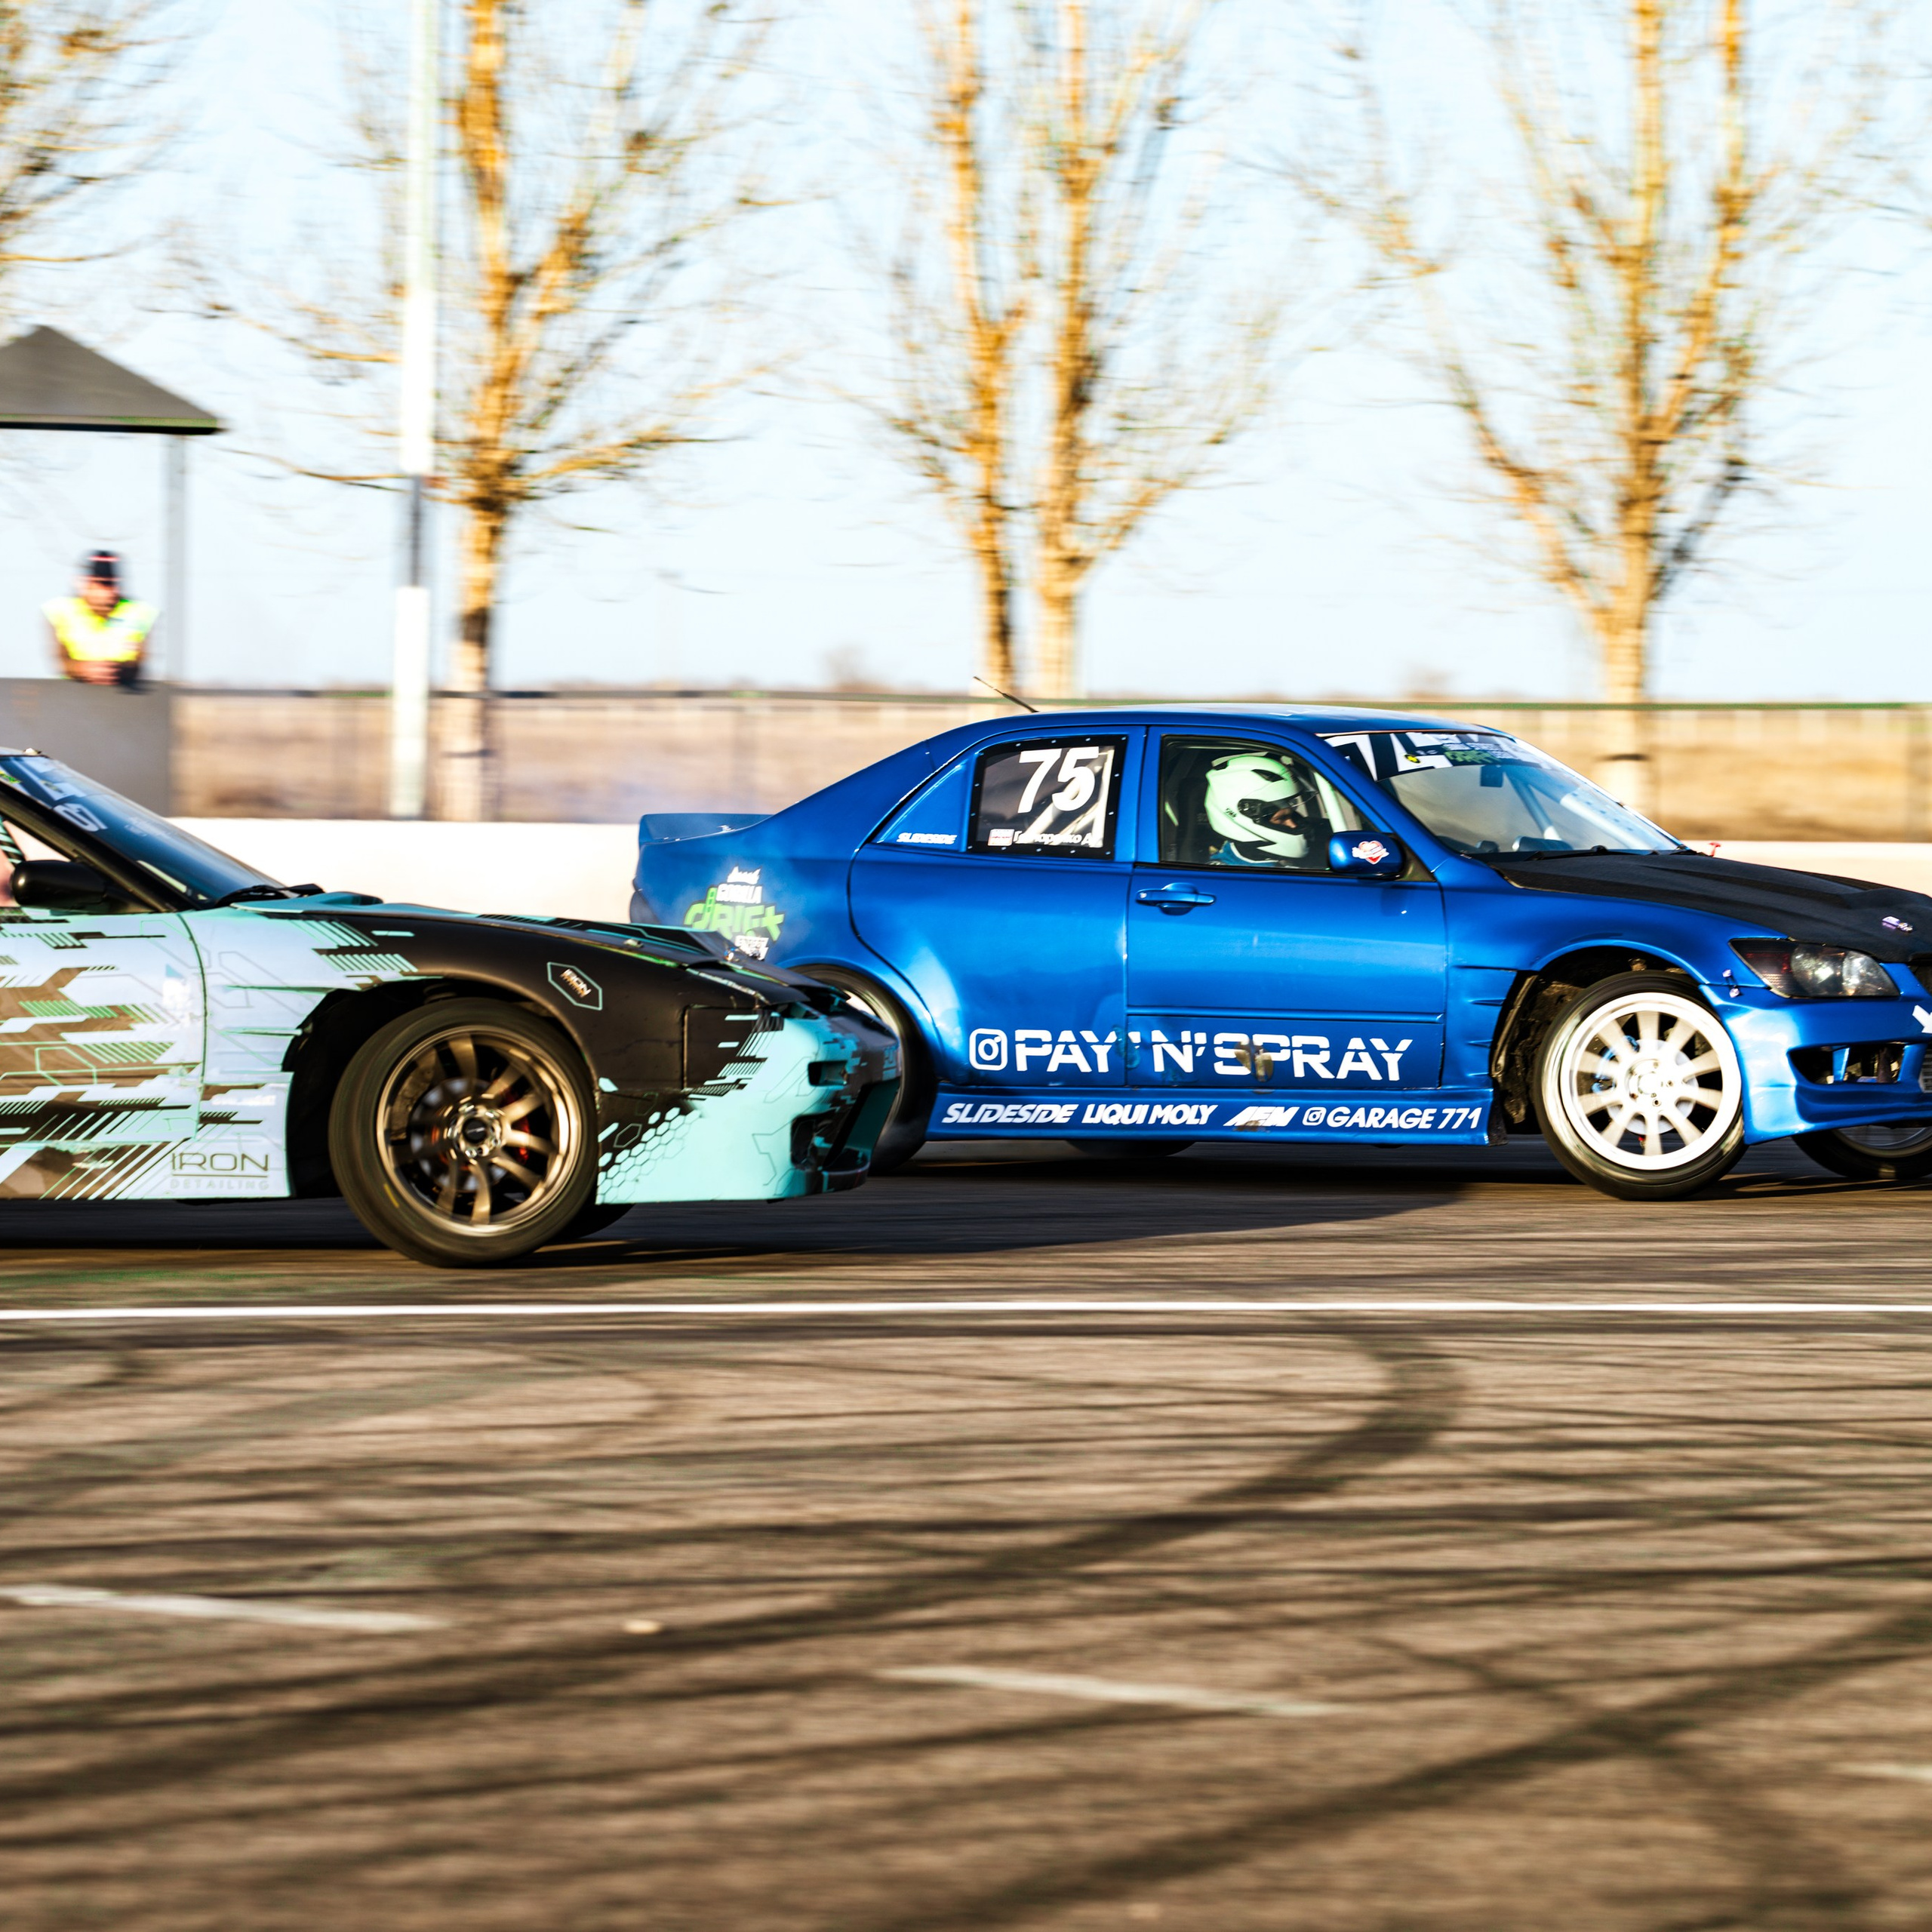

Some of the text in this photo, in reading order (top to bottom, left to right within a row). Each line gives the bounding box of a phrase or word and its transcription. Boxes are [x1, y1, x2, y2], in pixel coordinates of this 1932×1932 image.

[1017, 746, 1099, 814] 75
[1213, 1032, 1414, 1081] SPRAY
[942, 1103, 1079, 1124] SLIDESIDE
[1081, 1103, 1218, 1126] LIQUI MOLY
[1326, 1106, 1482, 1129] GARAGE 771
[171, 1152, 269, 1171] IRON
[170, 1178, 269, 1191] DETAILING
